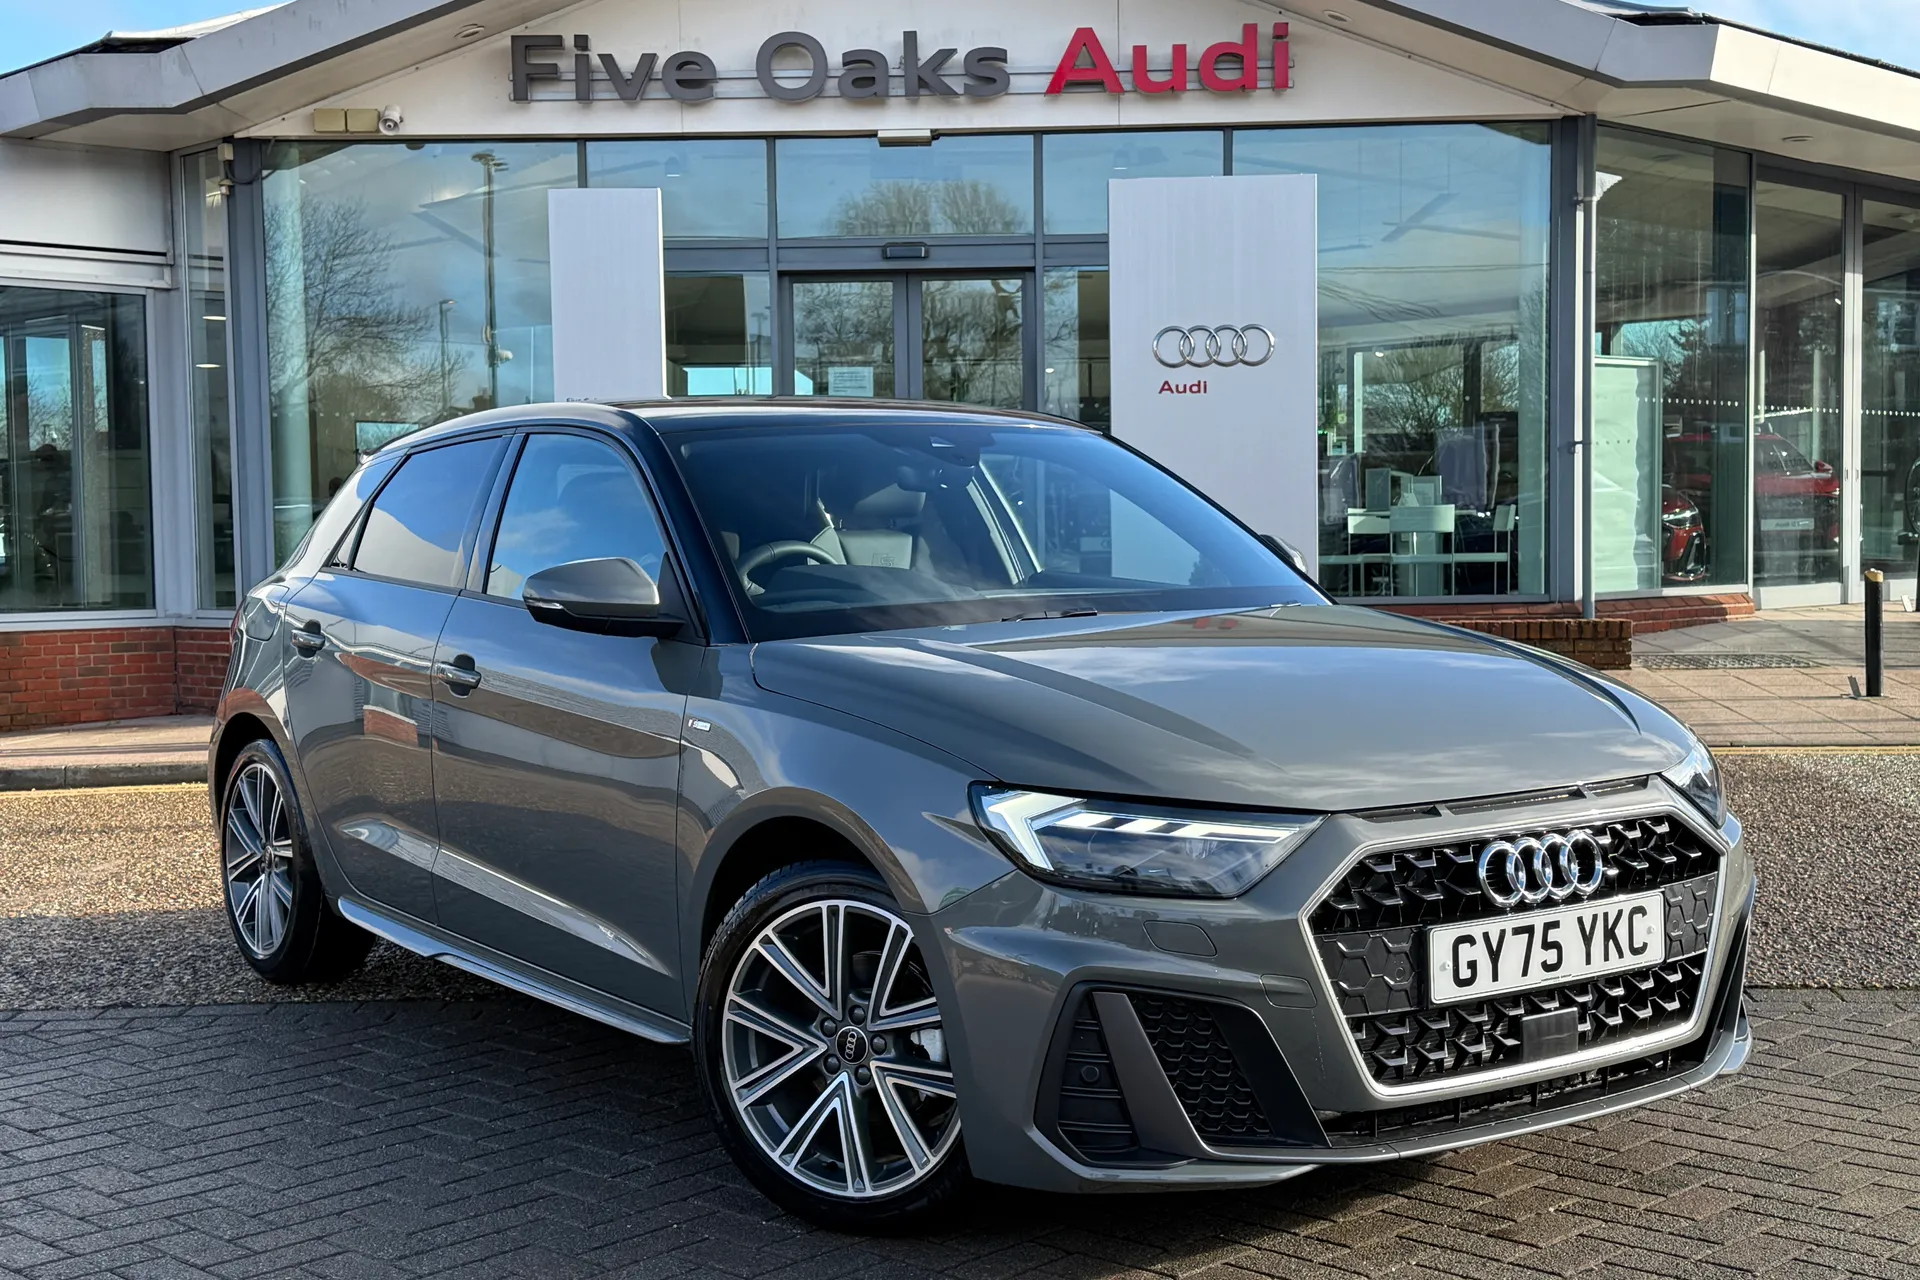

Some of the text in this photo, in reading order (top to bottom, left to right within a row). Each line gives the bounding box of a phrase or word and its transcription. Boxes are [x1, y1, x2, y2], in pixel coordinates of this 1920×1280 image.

[511, 22, 1289, 104] Five Oaks Audi
[1158, 380, 1207, 394] Audi
[1452, 905, 1649, 988] GY75 YKC
